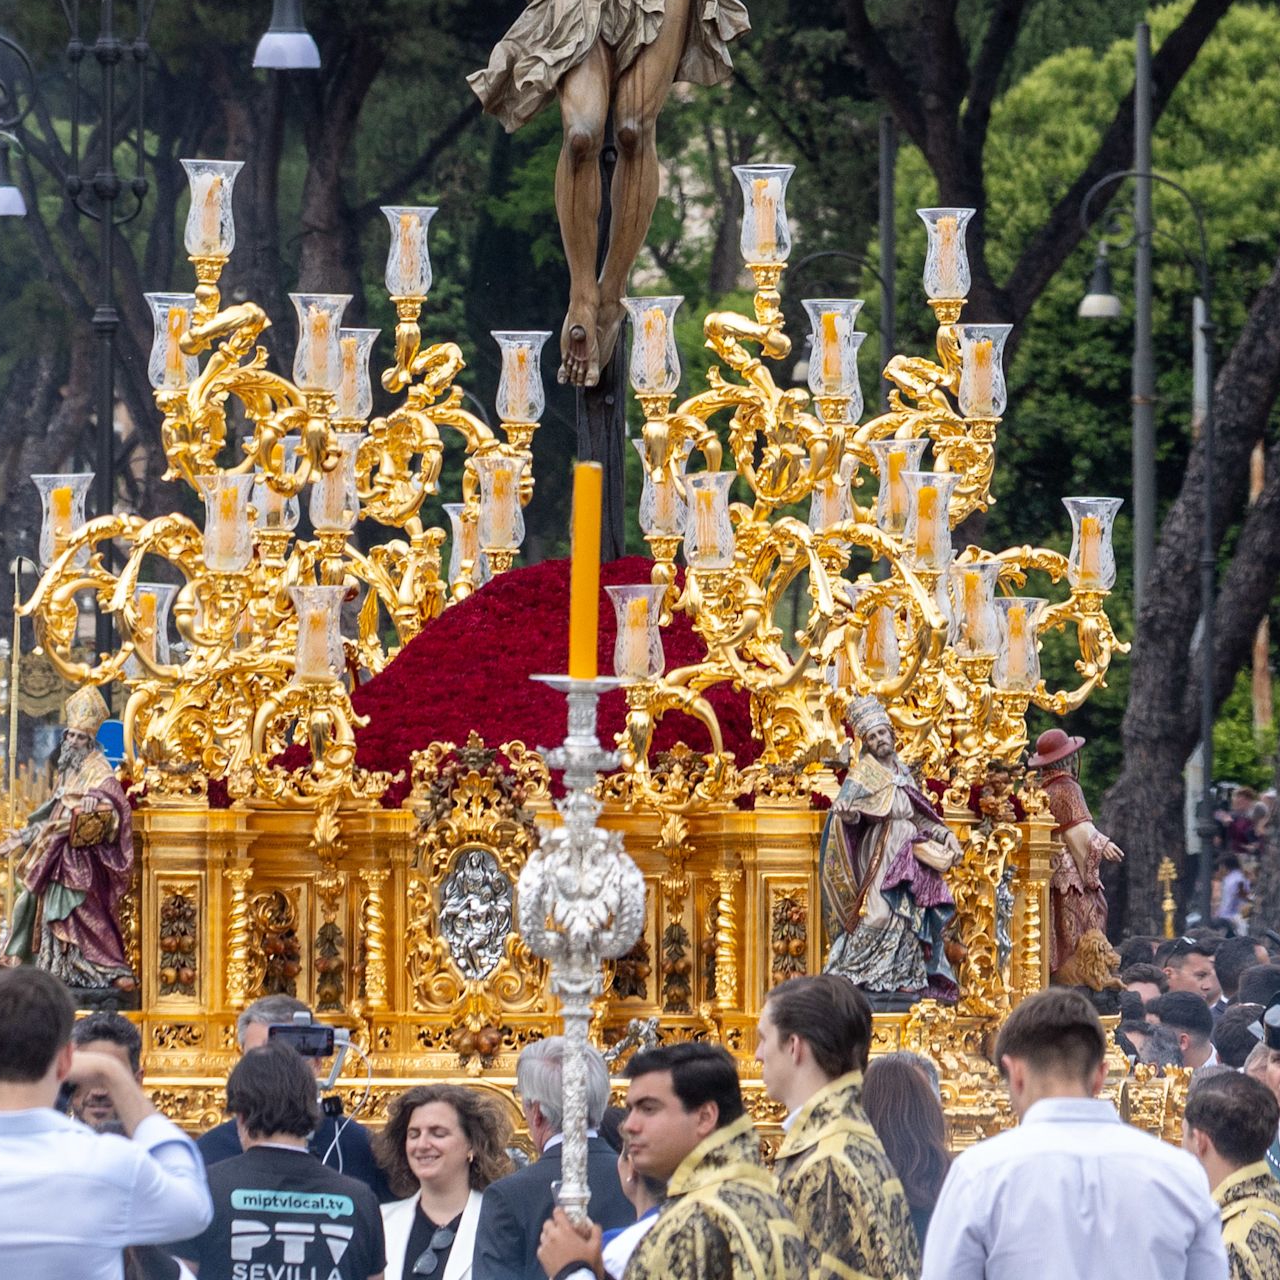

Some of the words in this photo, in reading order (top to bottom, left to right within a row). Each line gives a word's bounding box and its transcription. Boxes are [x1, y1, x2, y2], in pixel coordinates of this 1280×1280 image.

[243, 1193, 344, 1211] miptvlocal.tv
[231, 1219, 354, 1265] PTV
[232, 1263, 343, 1280] SEVILLA
